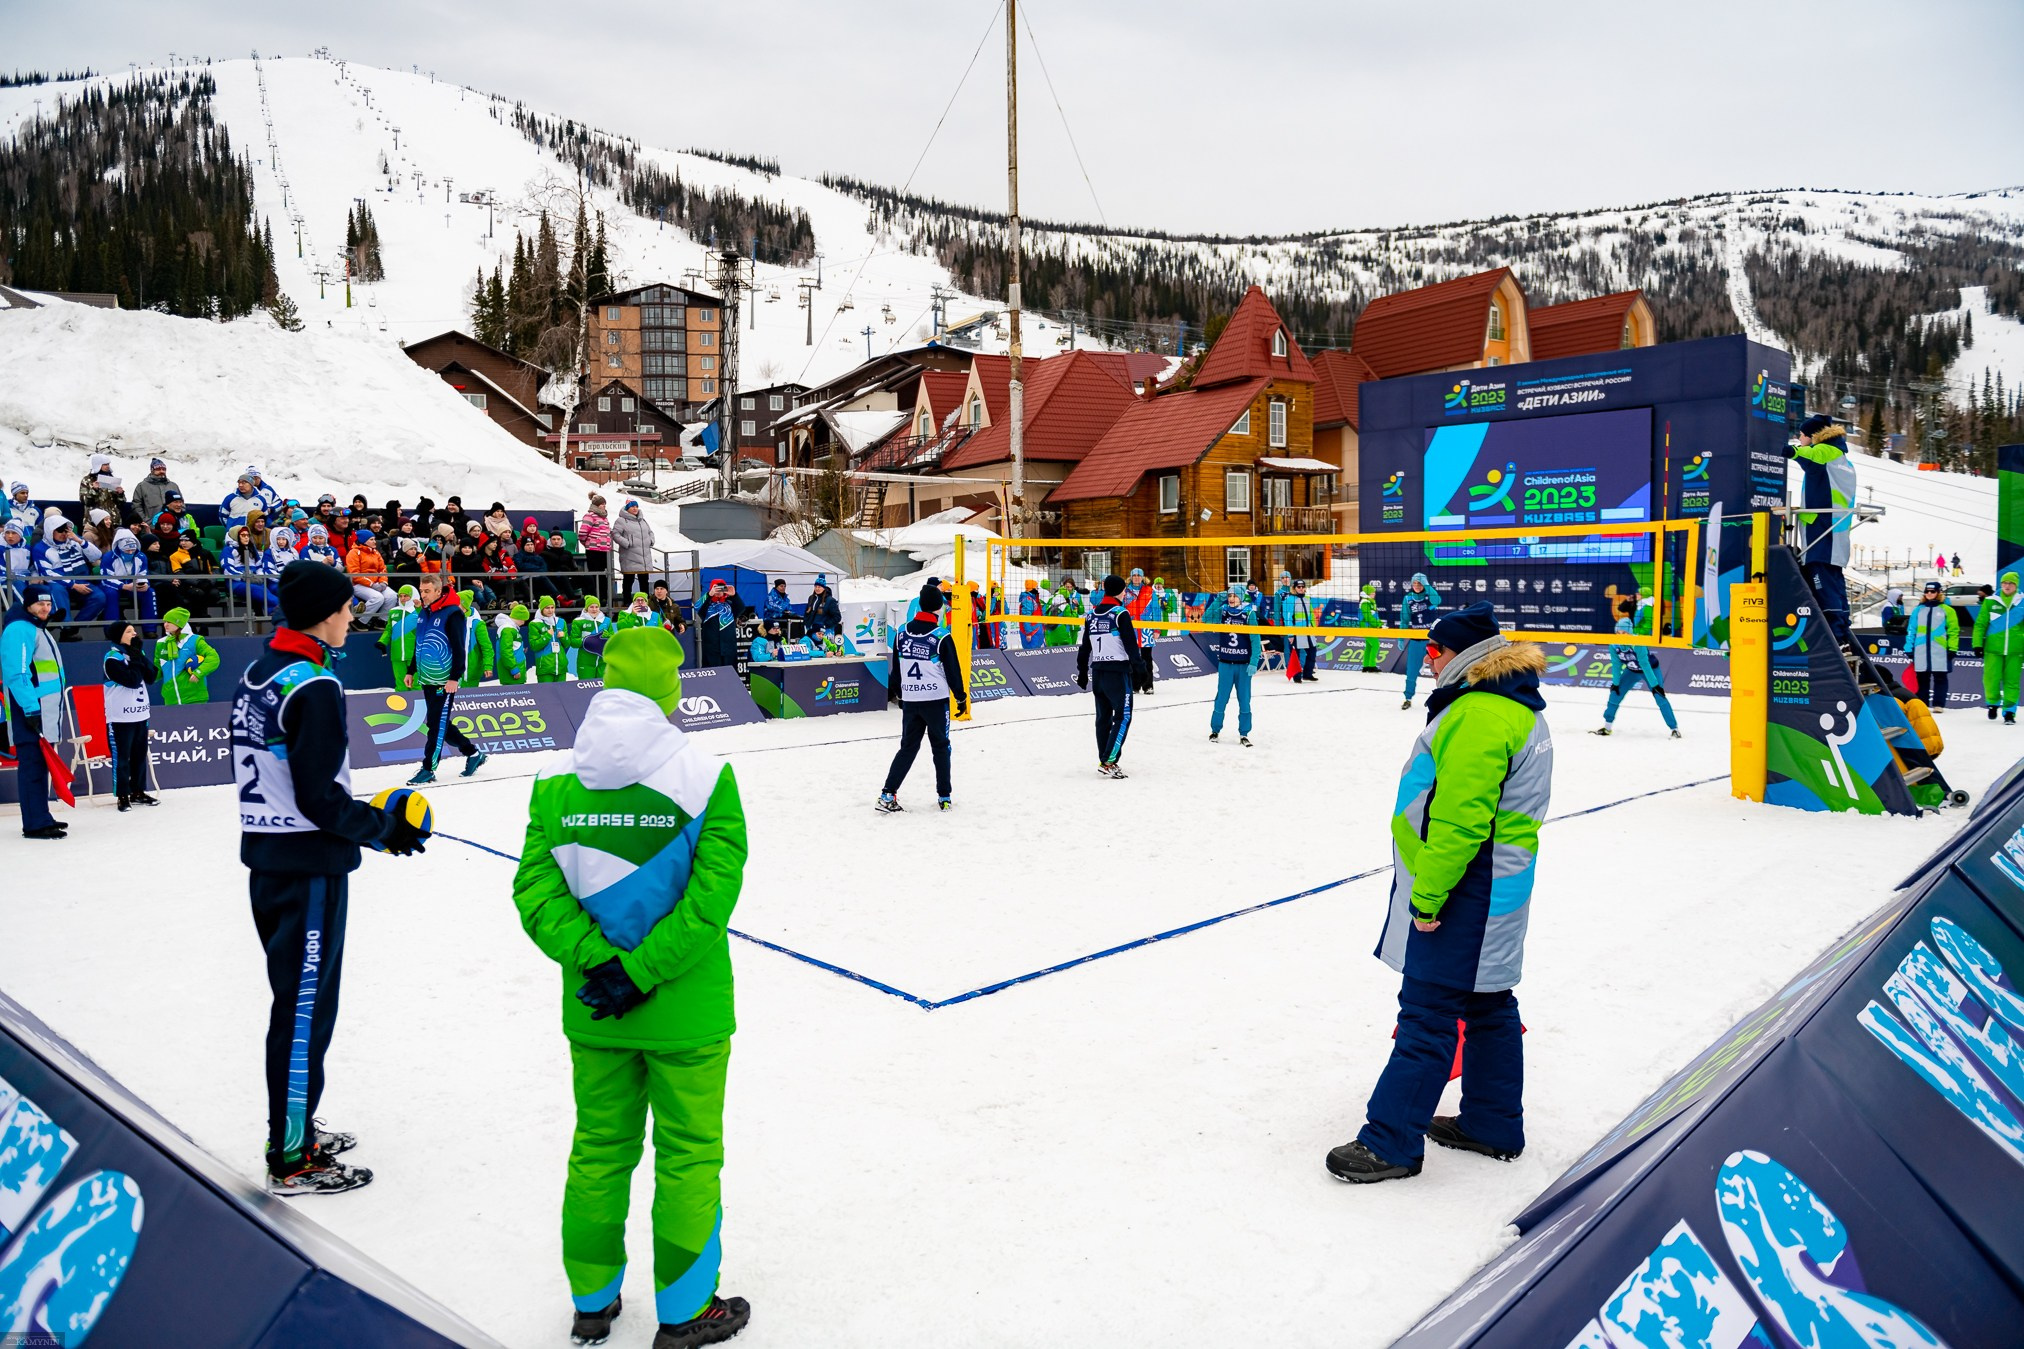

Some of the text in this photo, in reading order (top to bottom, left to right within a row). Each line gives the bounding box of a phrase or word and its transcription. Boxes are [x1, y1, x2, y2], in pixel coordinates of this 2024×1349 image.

[1471, 390, 1506, 406] 2023
[1517, 389, 1606, 410] «ДЕТИ АЗИИ»
[1524, 473, 1596, 485] Children of Asia
[1524, 485, 1596, 510] 2023
[1523, 511, 1596, 524] KUZBASS
[1511, 546, 1521, 555] 17
[1096, 636, 1102, 653] 1
[1228, 632, 1239, 647] 3
[1220, 647, 1248, 655] KUZBASS
[698, 669, 717, 678] 2023
[907, 661, 923, 680] 4
[835, 687, 859, 699] 2023
[970, 688, 1016, 699] UZBASS
[1773, 679, 1810, 694] 2023
[497, 698, 509, 707] of
[510, 696, 536, 707] Asia
[1773, 696, 1810, 705] KUZBASS
[451, 710, 547, 739] 2023
[475, 736, 556, 753] UZBASS
[239, 753, 267, 805] 2
[561, 814, 676, 828] KUZBASS 2023
